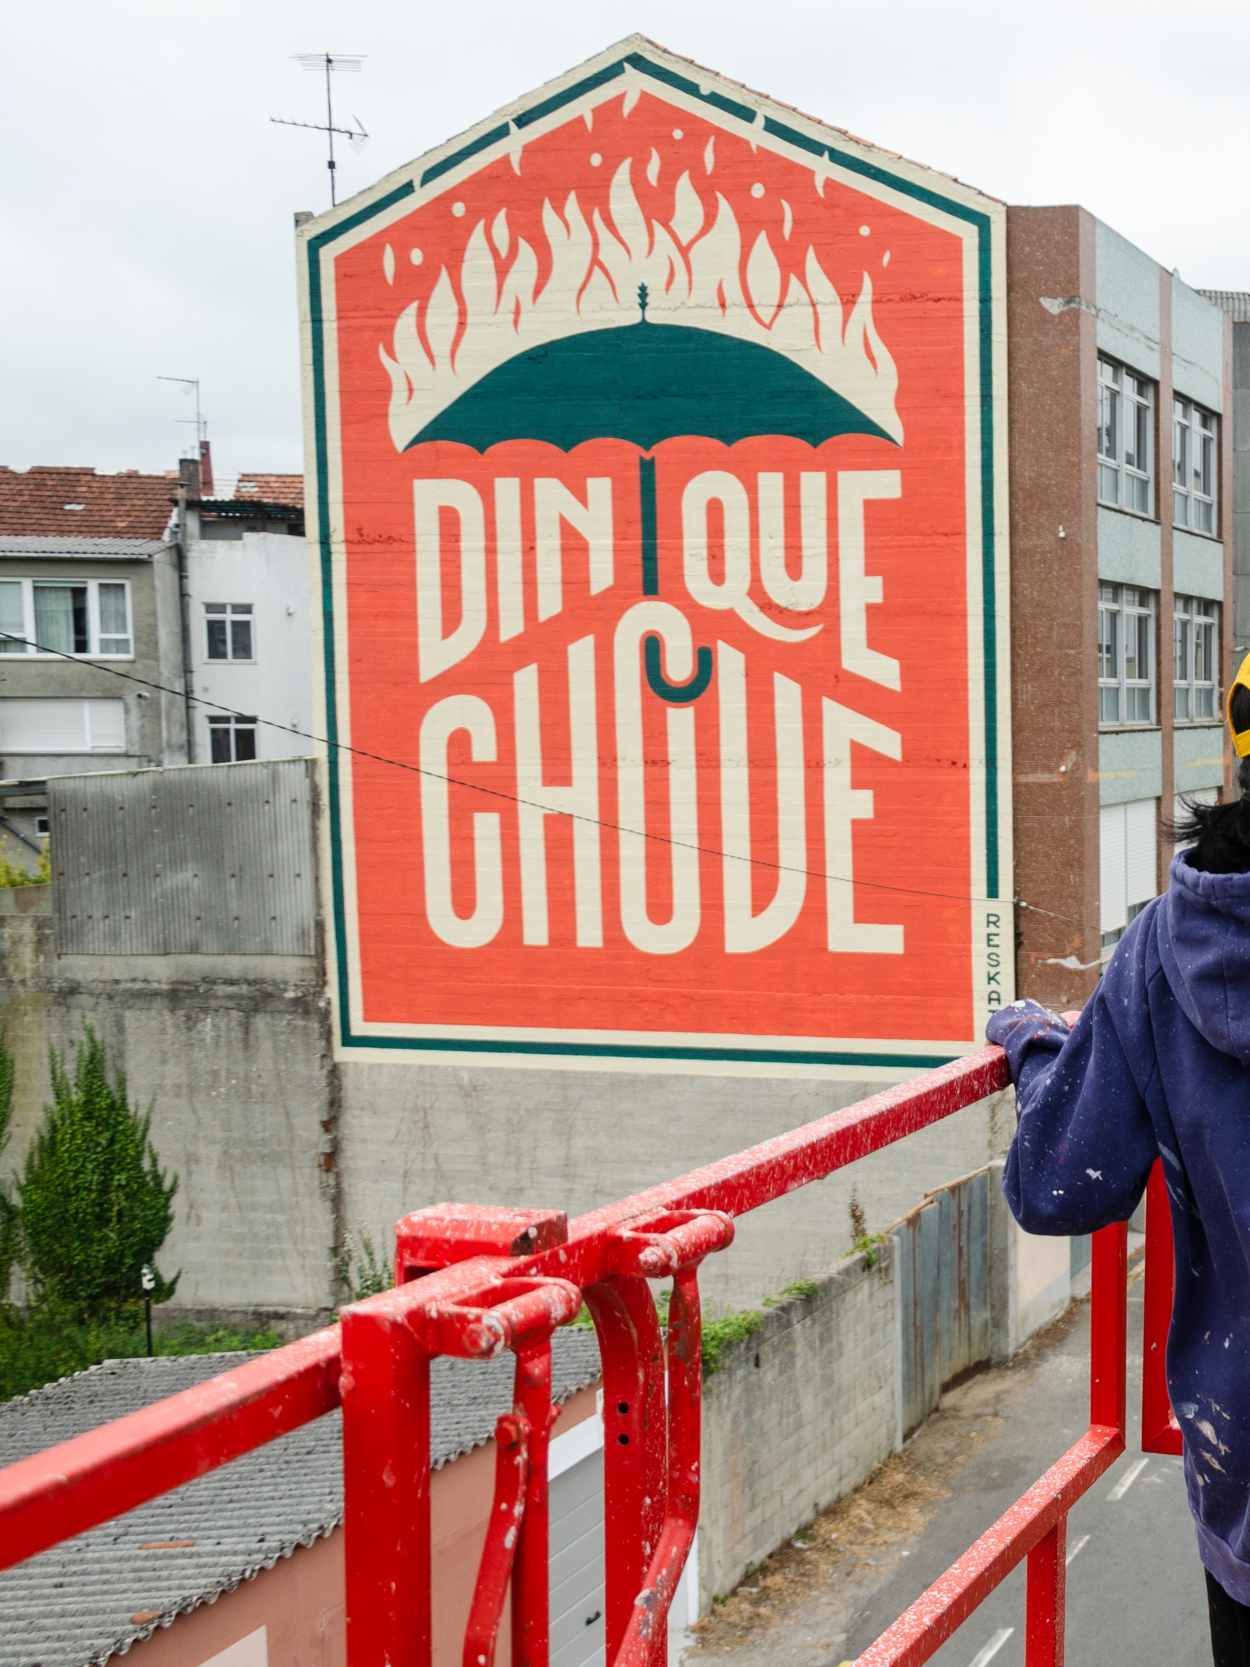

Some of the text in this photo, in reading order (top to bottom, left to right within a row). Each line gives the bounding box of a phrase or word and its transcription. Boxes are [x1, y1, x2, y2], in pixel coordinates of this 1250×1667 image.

[413, 469, 902, 692] DIN QUE
[986, 913, 1001, 1014] RESKA
